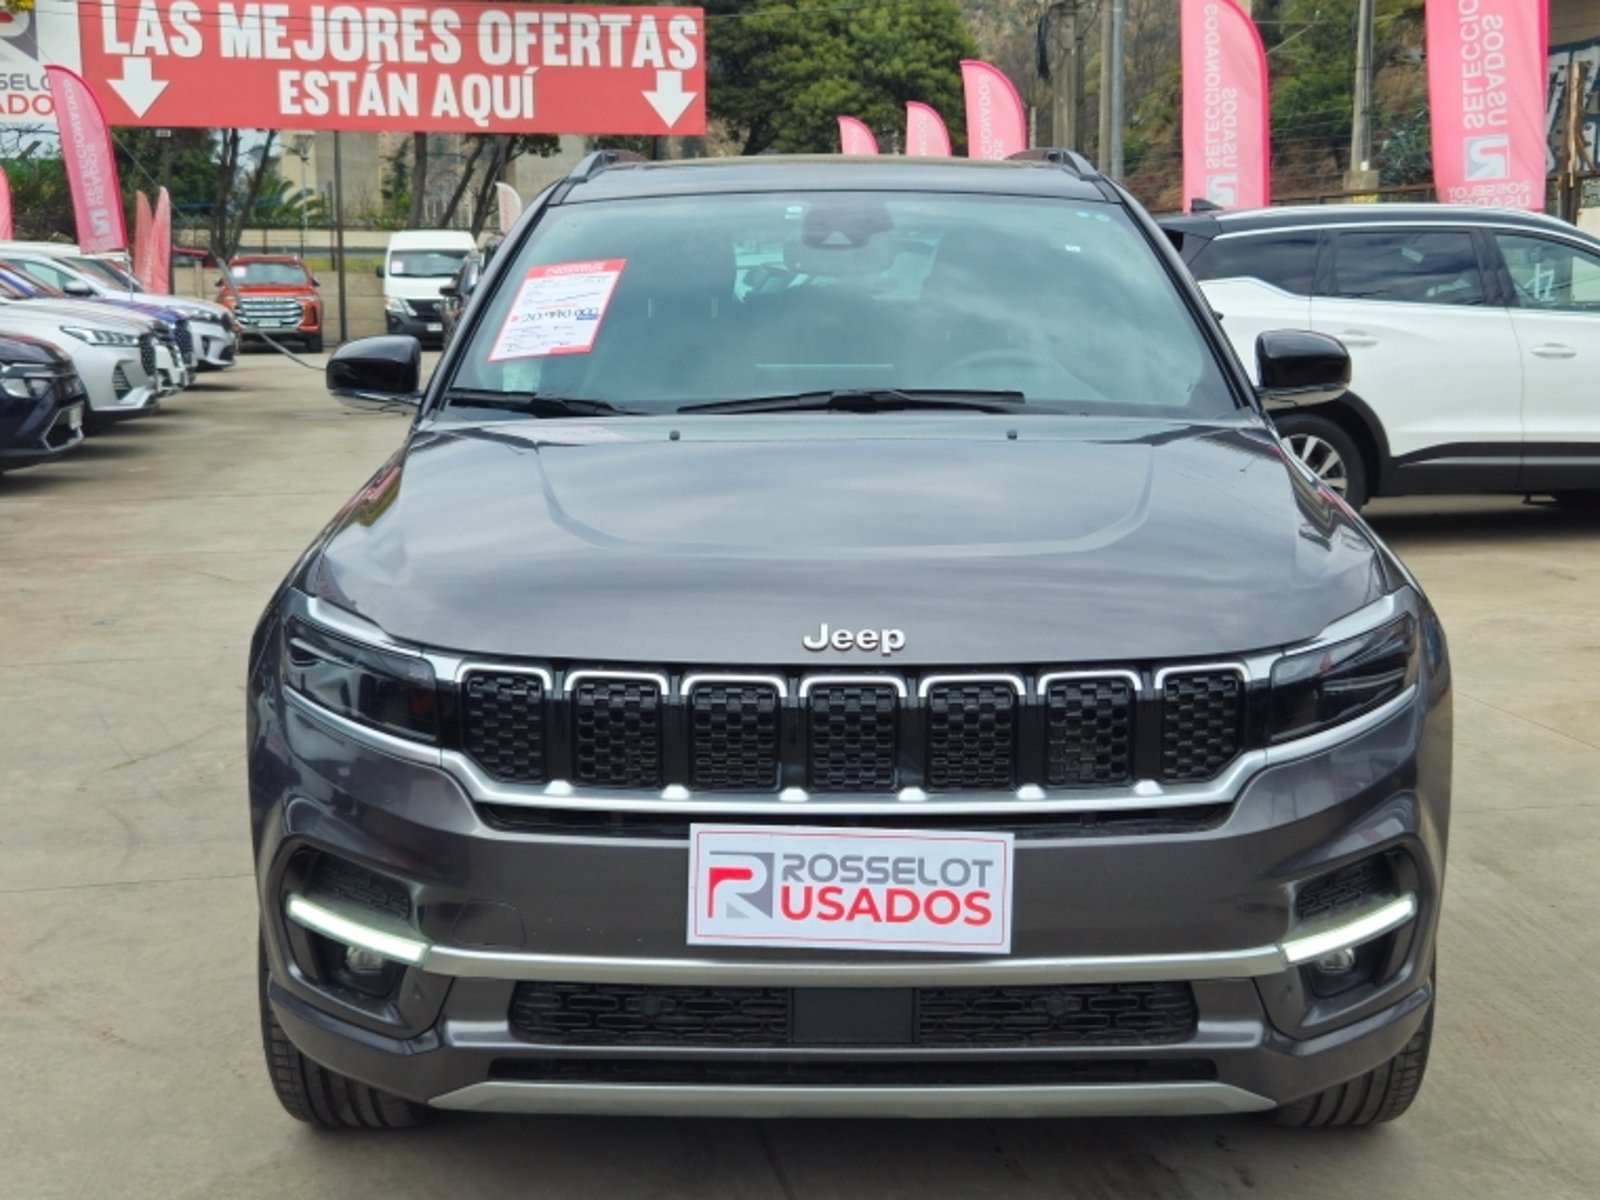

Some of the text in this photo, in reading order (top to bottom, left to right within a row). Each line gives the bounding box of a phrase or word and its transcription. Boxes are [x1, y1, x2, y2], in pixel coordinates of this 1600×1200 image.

[101, 0, 698, 70] LAS MEJORES OFERTAS
[278, 63, 540, 127] ESTÁN AQUÍ
[802, 623, 906, 657] Jeep
[782, 853, 994, 888] ROSSELOT
[780, 885, 993, 927] USADOS
